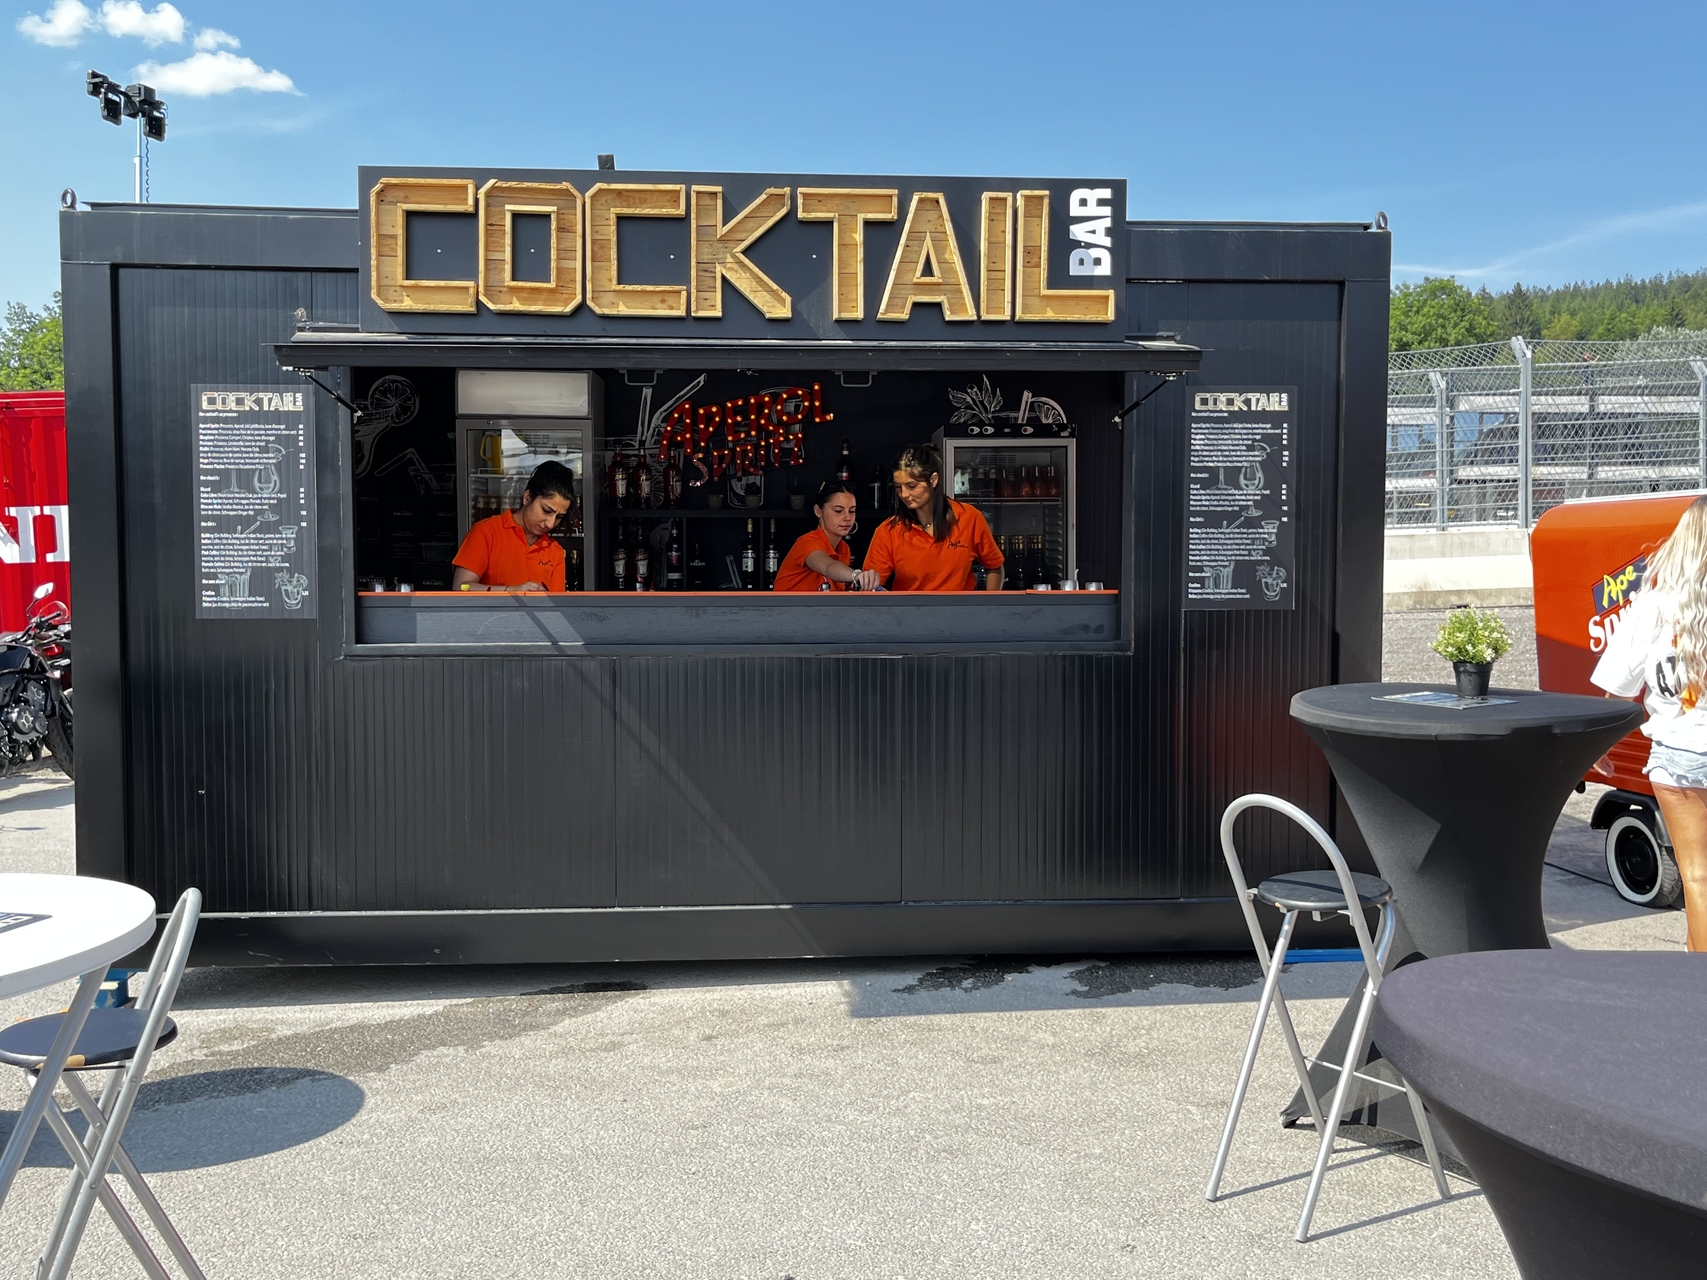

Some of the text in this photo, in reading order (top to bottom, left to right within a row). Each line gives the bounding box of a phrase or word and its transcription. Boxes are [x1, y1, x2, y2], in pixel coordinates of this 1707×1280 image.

[370, 177, 1115, 322] COCKTAIL
[1068, 187, 1114, 277] BAR
[201, 391, 304, 411] COCKTAIL
[658, 382, 834, 462] APEROL
[1194, 392, 1289, 412] COCKTAIL
[689, 432, 804, 487] SPRITZ
